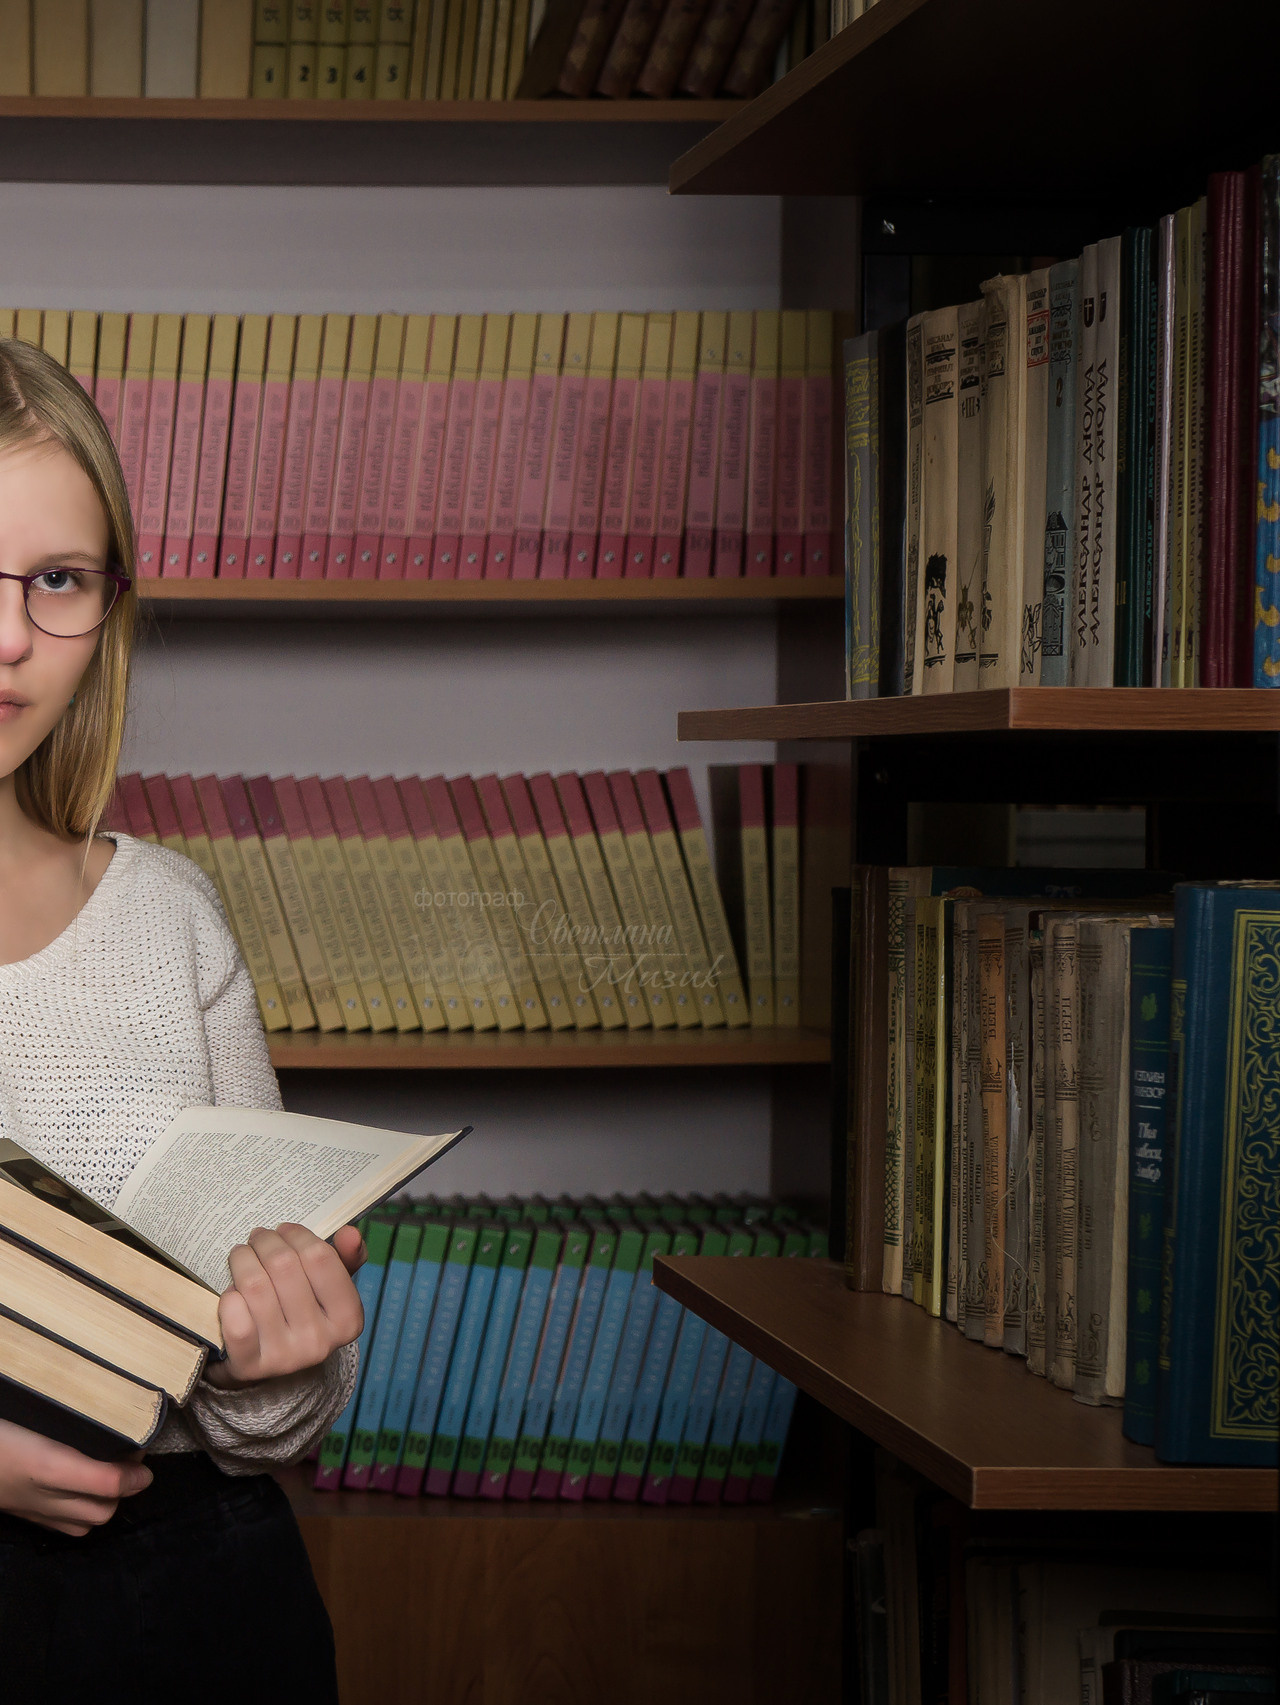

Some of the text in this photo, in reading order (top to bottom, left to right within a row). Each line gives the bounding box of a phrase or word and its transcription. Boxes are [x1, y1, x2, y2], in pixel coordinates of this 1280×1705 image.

[1077, 362, 1095, 648] АЛЕКСАНДР ДЮМА
[1089, 357, 1108, 646] АЛЕКСАНДР ДЮМА
[988, 996, 997, 1040] ВЕРН
[1061, 997, 1072, 1045] ВЕРН
[323, 1436, 344, 1454] 10
[352, 1435, 371, 1451] 10
[380, 1435, 400, 1451] 10
[408, 1437, 426, 1454] 10
[435, 1438, 454, 1456] 10
[463, 1441, 481, 1460] 10
[491, 1442, 512, 1460] 10
[521, 1442, 539, 1460] 10
[548, 1441, 570, 1459] 10
[572, 1444, 592, 1462] 10
[598, 1444, 616, 1462] 10
[623, 1444, 643, 1462] 10
[653, 1444, 672, 1463] 10
[682, 1445, 702, 1464] 10
[710, 1446, 730, 1466] 10
[736, 1447, 757, 1465] 10
